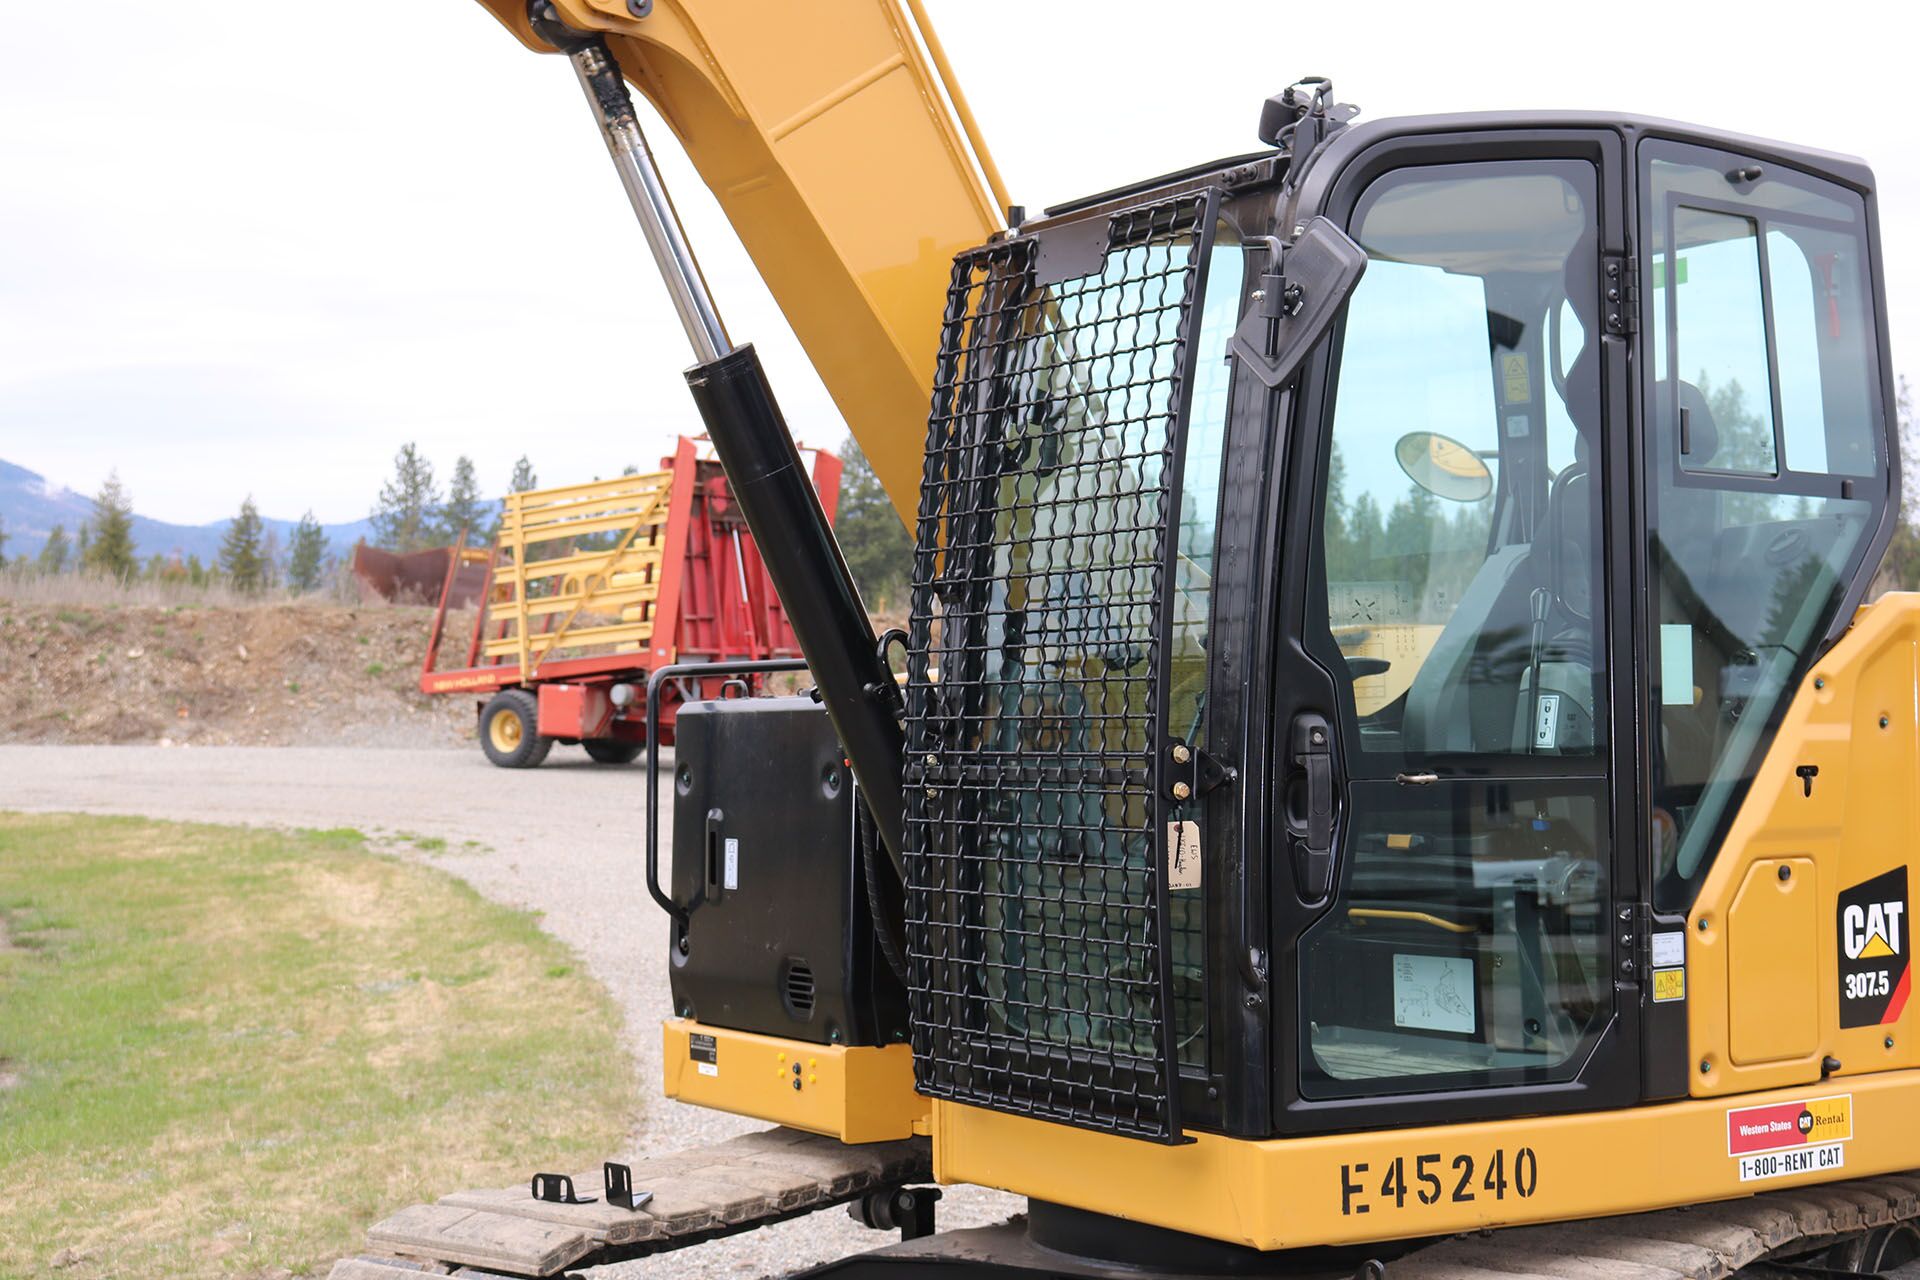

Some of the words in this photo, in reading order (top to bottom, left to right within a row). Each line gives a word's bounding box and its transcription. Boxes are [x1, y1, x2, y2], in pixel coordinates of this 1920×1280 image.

[1843, 901, 1903, 960] CAT
[1845, 970, 1890, 1000] 307.5
[1739, 1124, 1768, 1136] Western
[1770, 1120, 1792, 1132] States
[1799, 1116, 1812, 1129] CAT
[1815, 1113, 1844, 1125] Rental
[1742, 1151, 1814, 1178] 1-800-RENT
[1819, 1147, 1840, 1166] CAT
[1341, 1147, 1537, 1215] E45240
